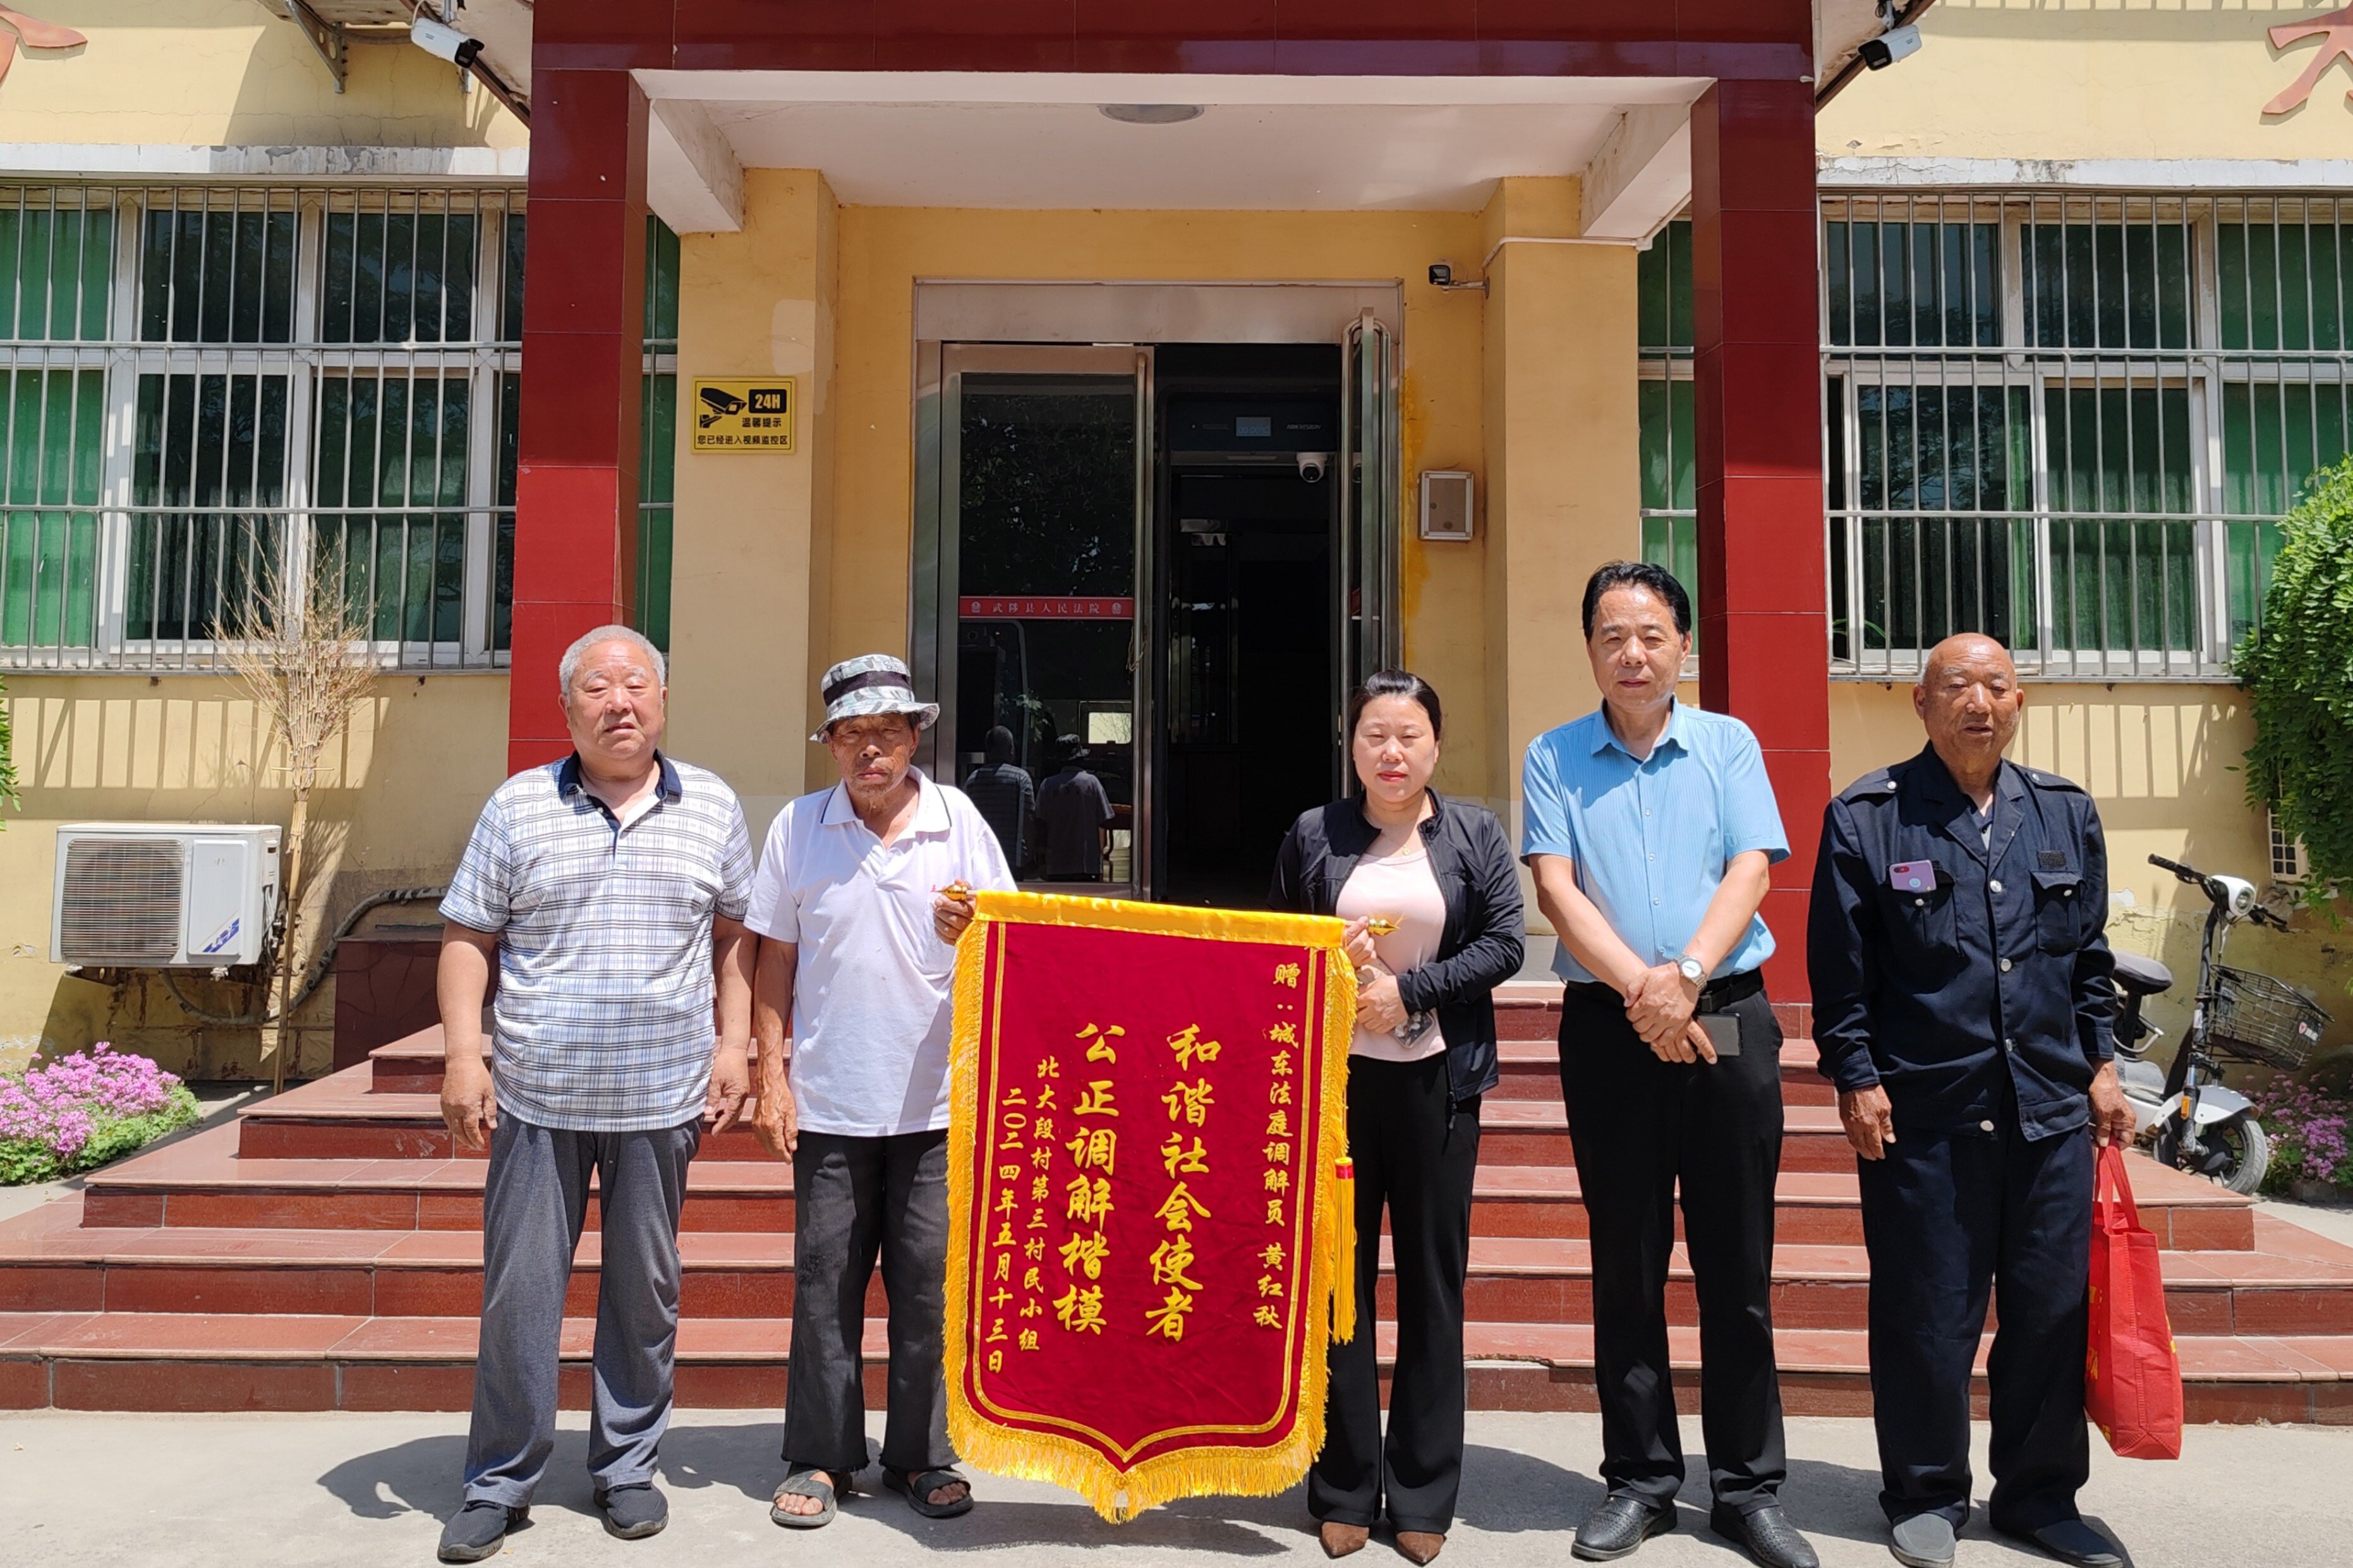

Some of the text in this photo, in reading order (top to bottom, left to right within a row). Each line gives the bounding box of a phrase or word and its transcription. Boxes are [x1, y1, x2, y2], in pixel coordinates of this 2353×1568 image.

[697, 435, 789, 445] 您已经进入视频监控区
[742, 417, 782, 428] 温馨提示
[754, 394, 781, 409] 24H
[1019, 1056, 1060, 1351] 北大段村第三村民小组
[1053, 1023, 1126, 1336] 公正调解楷模
[1145, 1023, 1221, 1341] 和谐社会使者
[1252, 1241, 1286, 1329] 黄红秋
